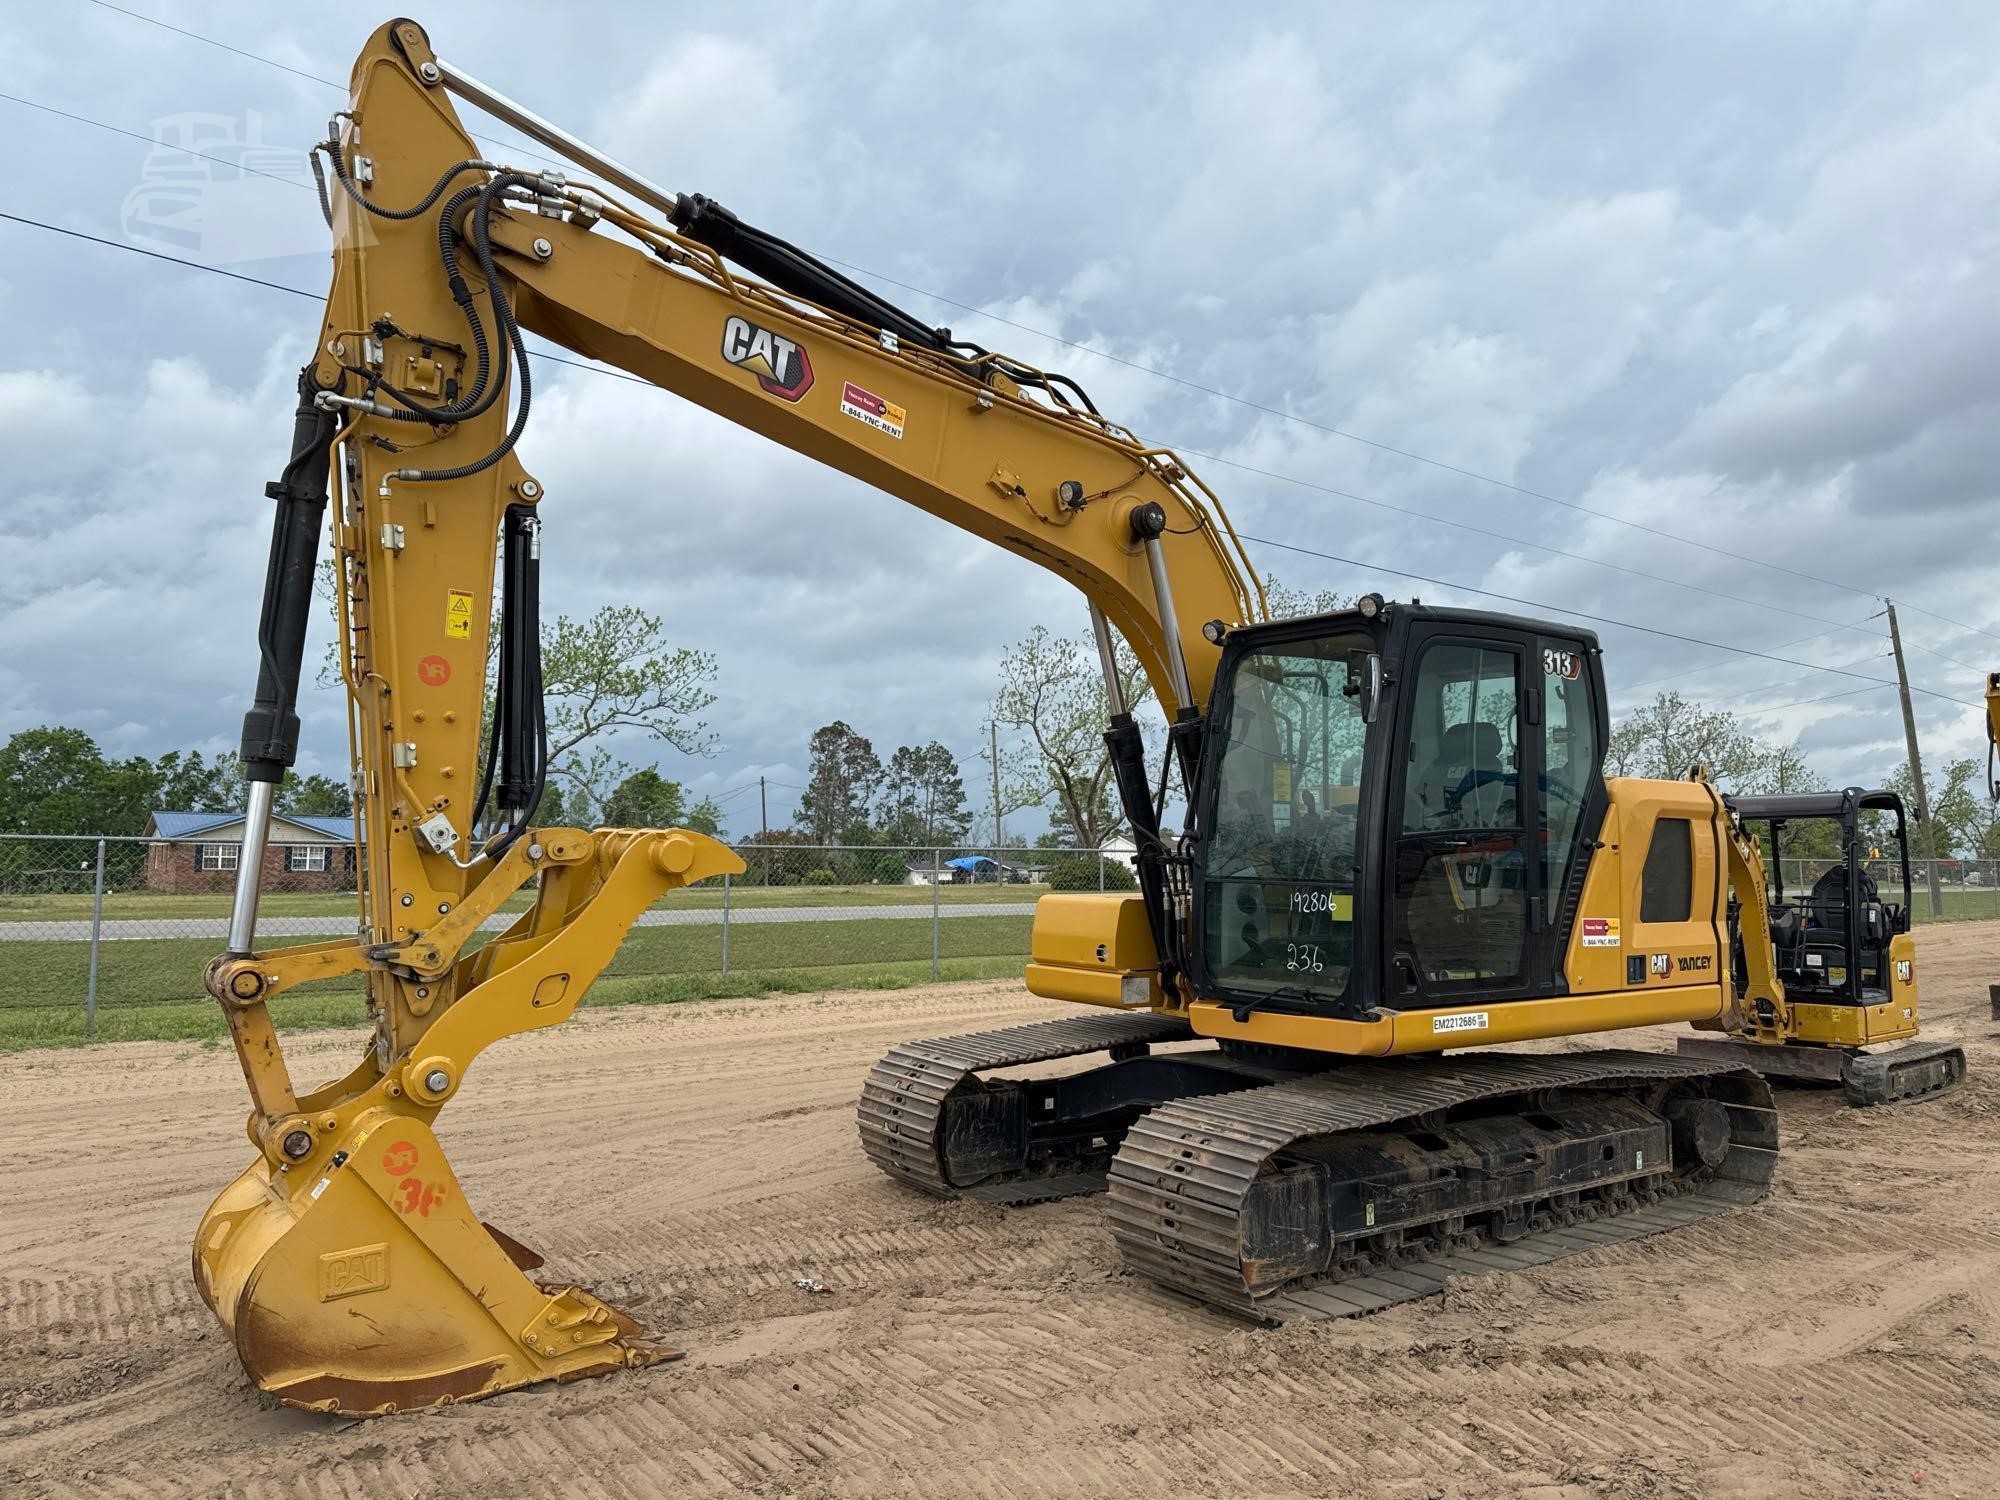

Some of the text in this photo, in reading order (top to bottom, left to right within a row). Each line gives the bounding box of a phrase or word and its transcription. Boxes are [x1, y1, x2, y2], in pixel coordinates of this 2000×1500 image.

[725, 316, 796, 383] CAT
[841, 404, 902, 438] 1-844-YNC-RENT
[1544, 648, 1571, 677] 313
[1289, 891, 1337, 913] 192806
[1286, 943, 1323, 972] 236
[1651, 954, 1712, 974] CAT YANCEY
[1897, 961, 1910, 981] CAT
[1434, 1016, 1477, 1030] EM2212686
[327, 1251, 383, 1288] CAT
